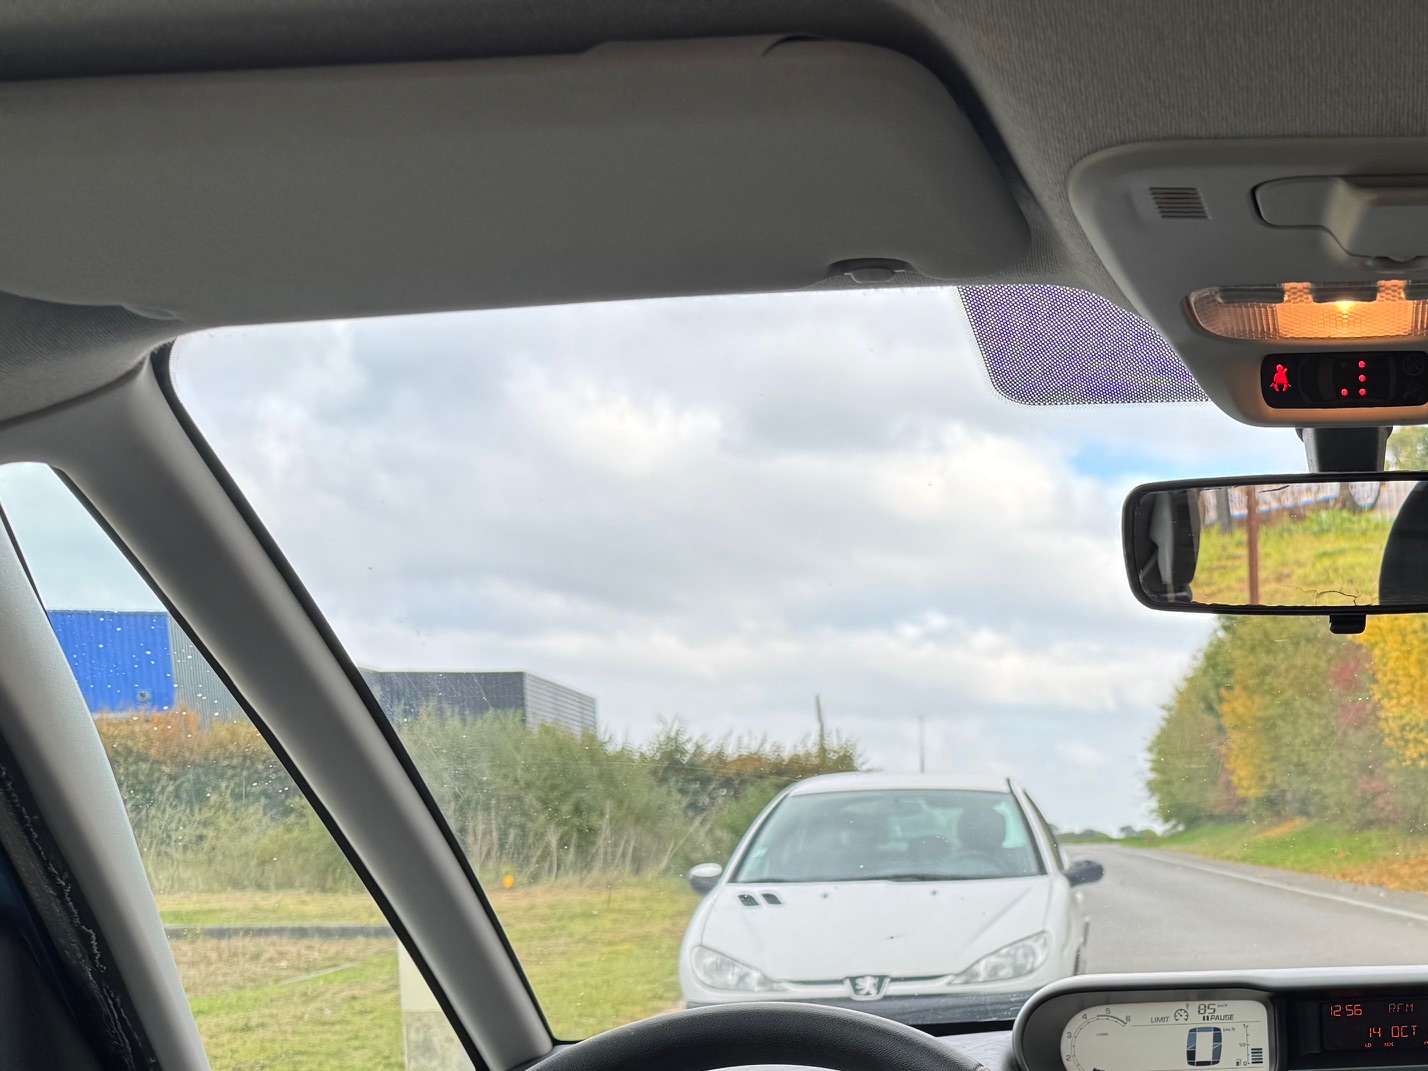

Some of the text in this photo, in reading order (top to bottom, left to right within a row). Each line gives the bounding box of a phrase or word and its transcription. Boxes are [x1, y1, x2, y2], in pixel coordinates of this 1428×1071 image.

[1105, 1007, 1111, 1015] 5
[1197, 1003, 1216, 1015] 85
[1330, 1003, 1363, 1017] 12:56
[1081, 1013, 1088, 1021] 4
[1125, 1015, 1131, 1023] 6
[1150, 1016, 1170, 1024] LIMIT
[1209, 1014, 1234, 1022] PAUSE
[1066, 1031, 1072, 1039] 3
[1369, 1026, 1383, 1038] 14
[1391, 1025, 1418, 1038] OCT
[1186, 1026, 1223, 1067] 0
[1065, 1054, 1072, 1062] 2
